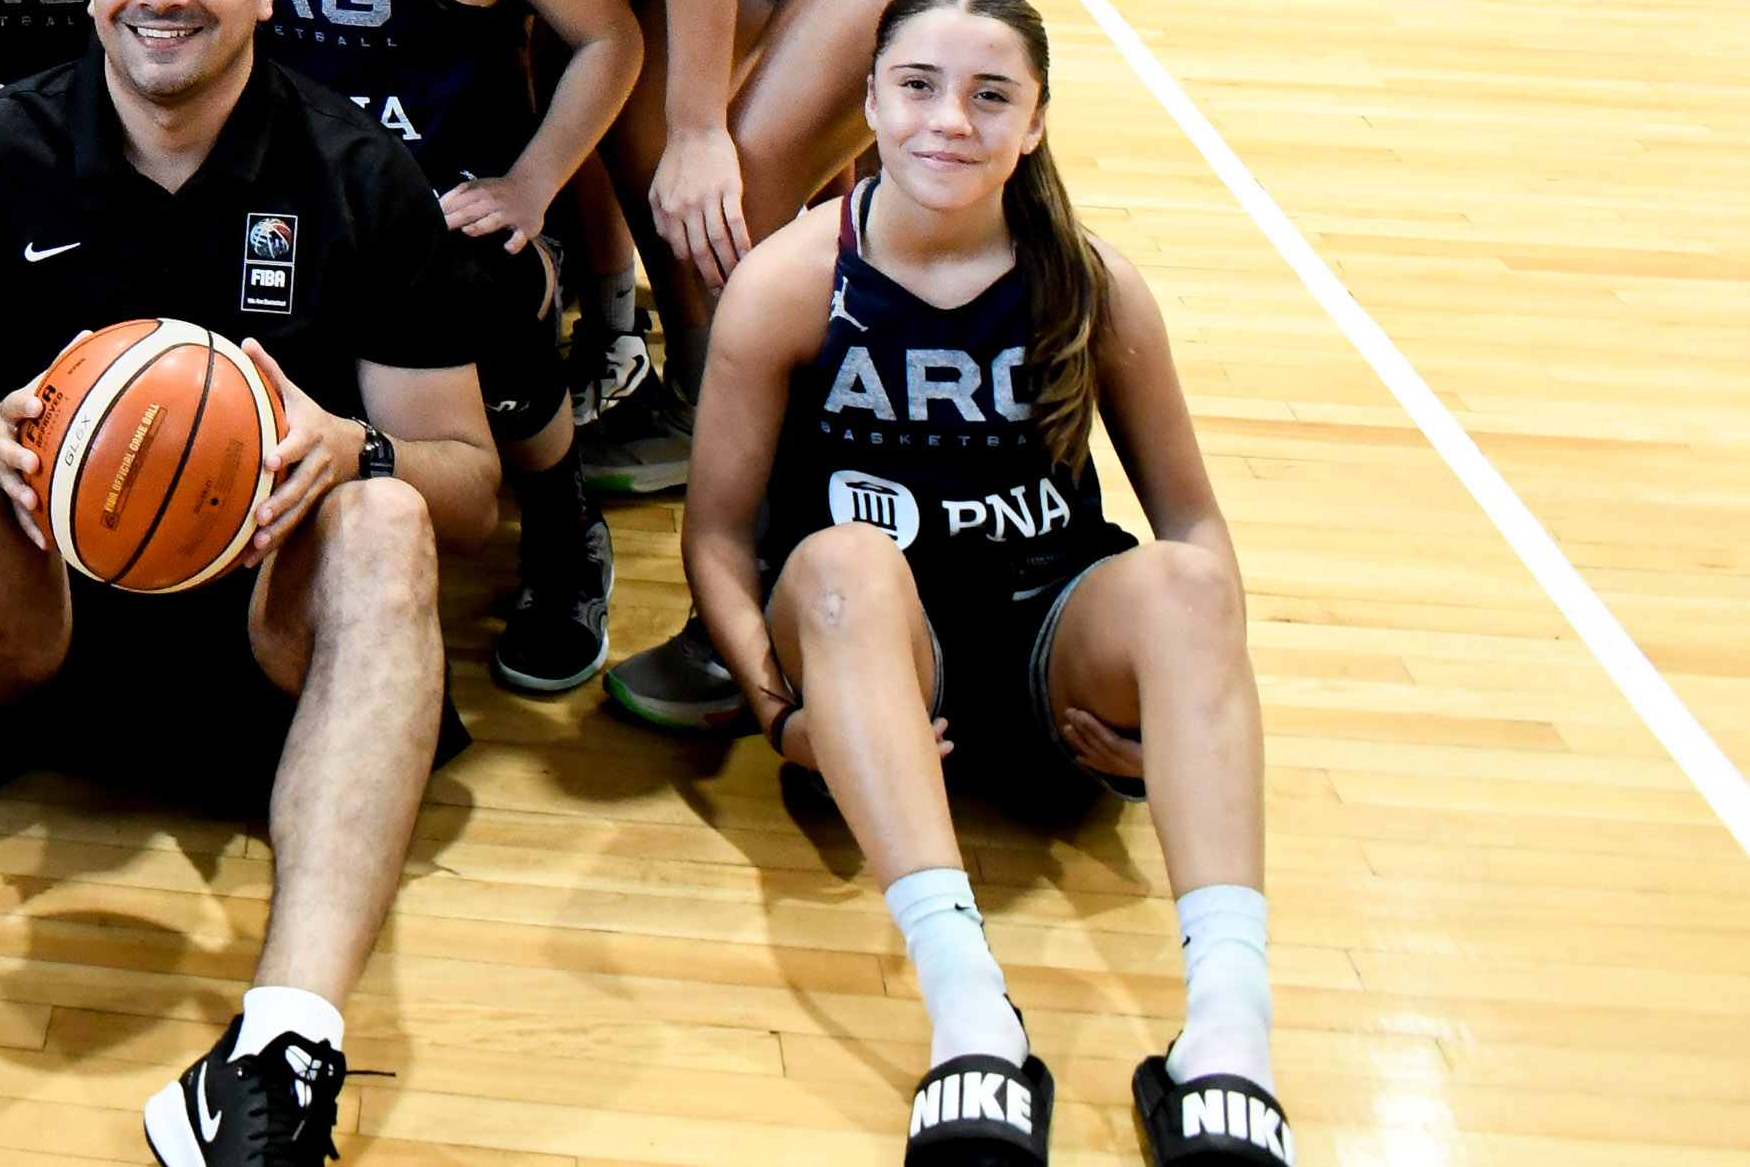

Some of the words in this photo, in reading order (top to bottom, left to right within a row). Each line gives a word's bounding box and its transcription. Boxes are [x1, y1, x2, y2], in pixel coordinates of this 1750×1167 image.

[251, 268, 286, 288] FIBA
[112, 450, 136, 491] OFFICIAL
[129, 425, 149, 451] GAME
[909, 1071, 1032, 1138] NIKE
